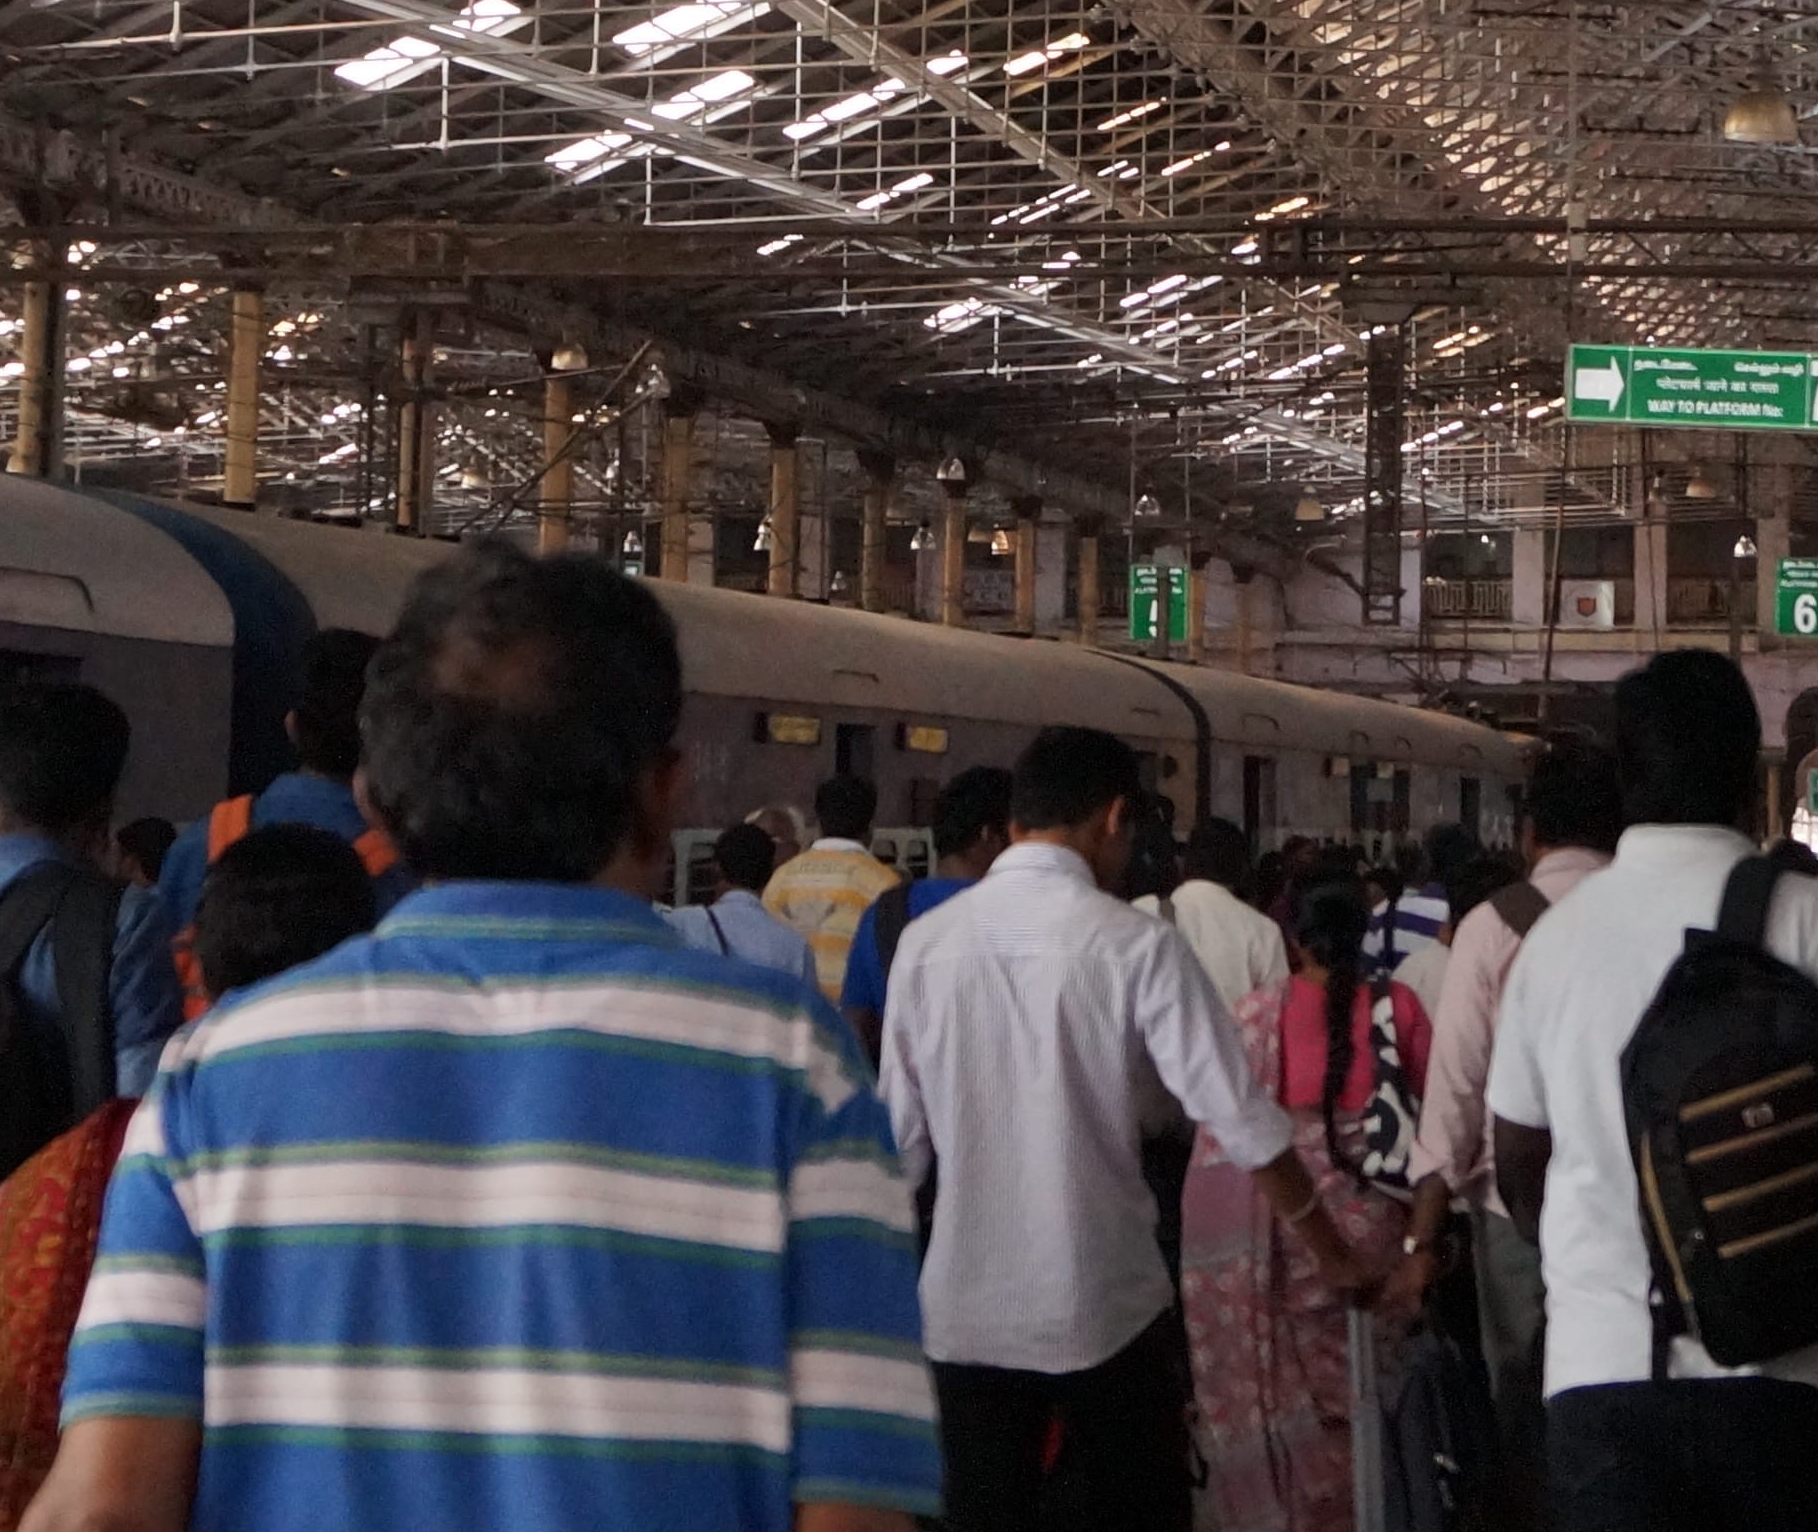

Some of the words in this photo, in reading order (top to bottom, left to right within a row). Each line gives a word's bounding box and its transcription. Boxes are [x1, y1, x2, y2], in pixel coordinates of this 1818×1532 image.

[1646, 399, 1675, 413] WAY
[1677, 400, 1695, 413] TO
[1696, 401, 1762, 417] PLATFORM
[1793, 593, 1818, 634] 6
